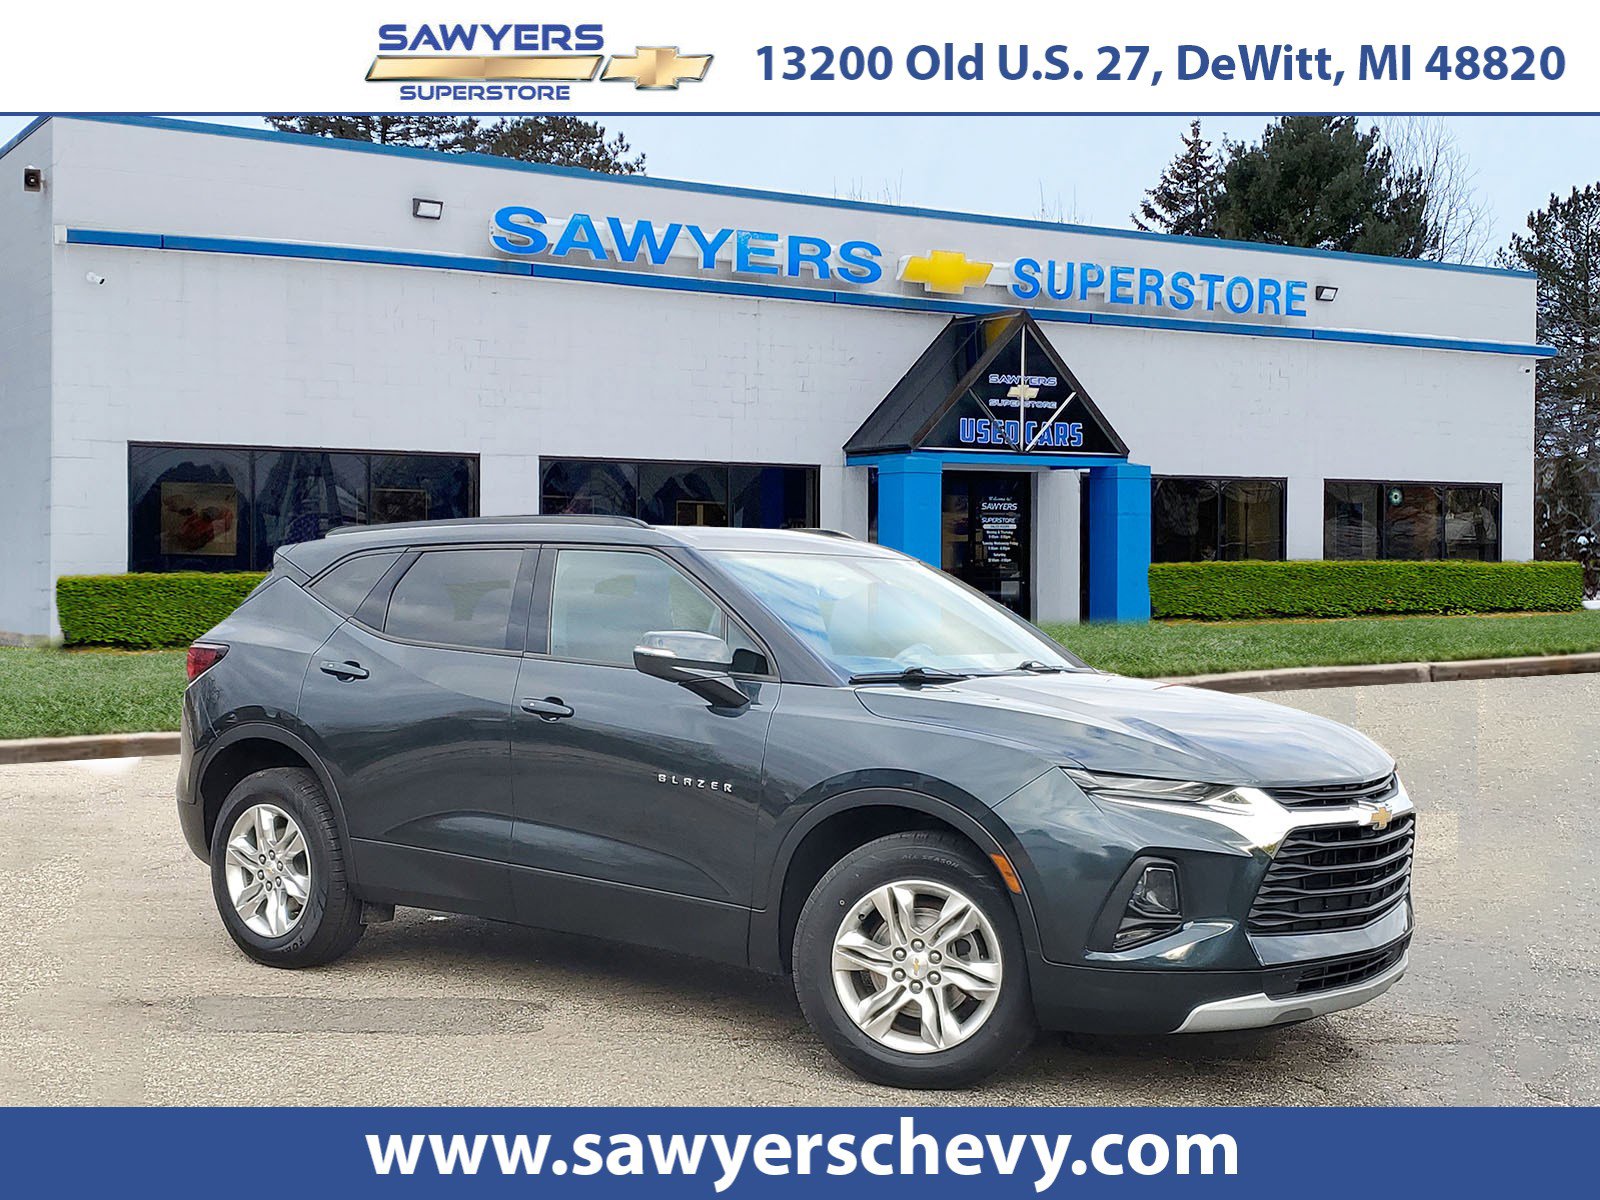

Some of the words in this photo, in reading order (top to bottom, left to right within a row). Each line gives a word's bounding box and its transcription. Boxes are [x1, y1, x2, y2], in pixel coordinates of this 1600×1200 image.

[490, 205, 884, 285] SAWYERS
[1009, 257, 1309, 318] SUPERSTORE
[988, 373, 1058, 387] SAWYERS
[959, 417, 1021, 446] USED
[1024, 421, 1084, 447] CARS
[981, 502, 1018, 511] SAWYERS
[657, 773, 733, 793] BLAZER
